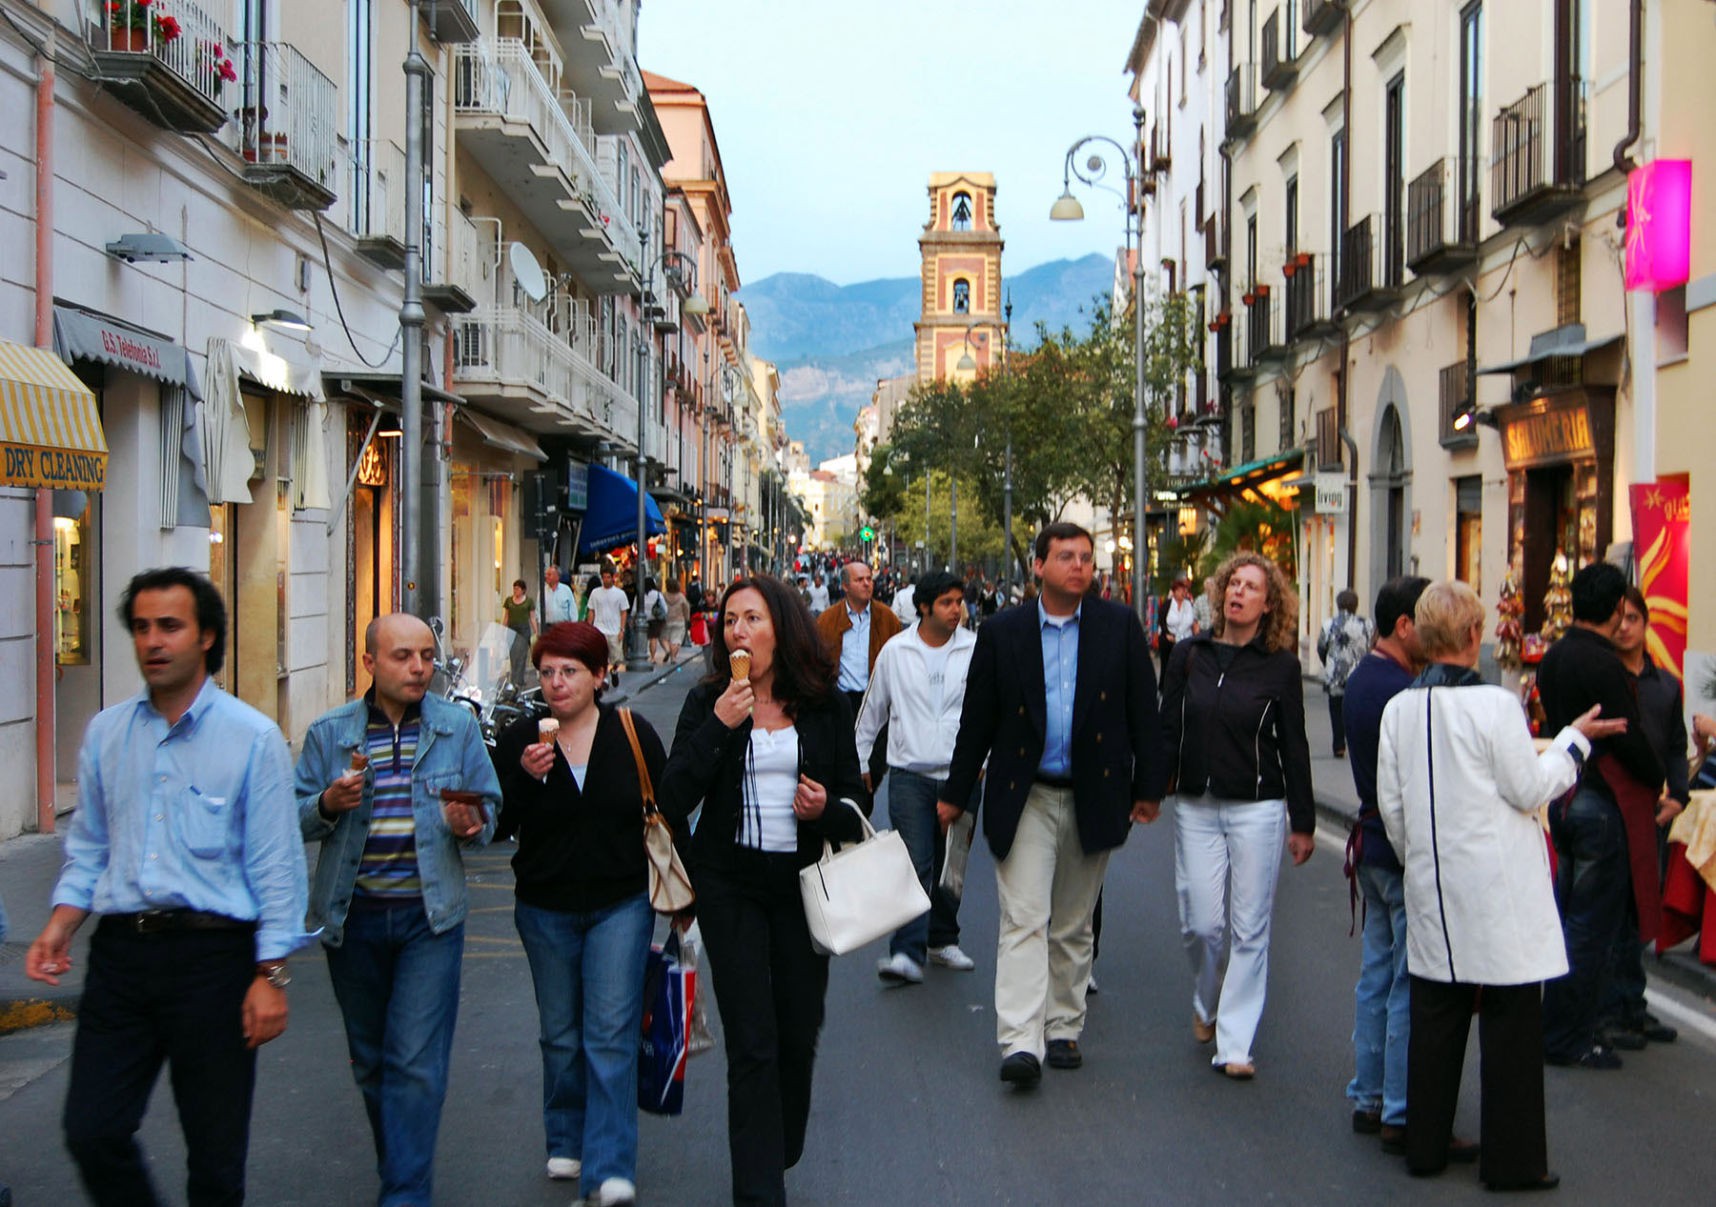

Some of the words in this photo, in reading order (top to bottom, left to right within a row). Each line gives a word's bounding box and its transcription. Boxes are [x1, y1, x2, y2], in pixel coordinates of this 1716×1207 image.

[1507, 406, 1591, 461] SALUMERIA
[5, 447, 34, 478] DRY
[40, 451, 104, 483] CLEANING
[1317, 488, 1343, 508] living
